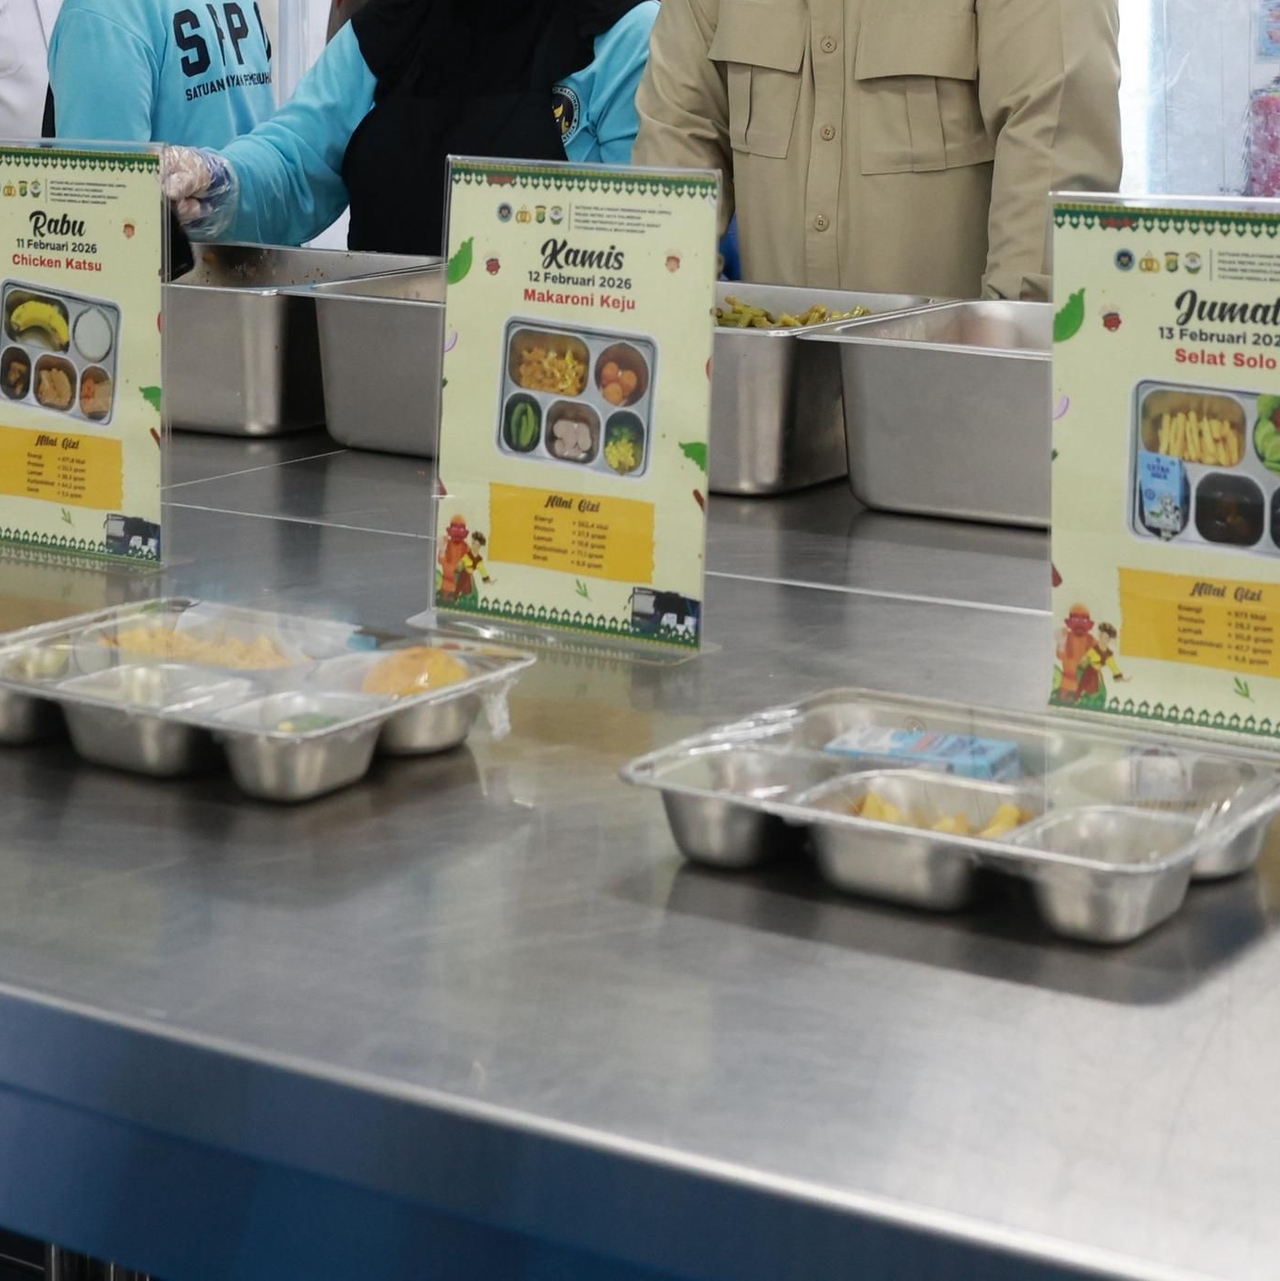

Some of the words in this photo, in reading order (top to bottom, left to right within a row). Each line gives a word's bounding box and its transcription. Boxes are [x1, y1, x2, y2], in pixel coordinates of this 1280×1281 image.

[185, 75, 226, 101] SATUAN
[29, 210, 86, 238] Rabu
[16, 239, 24, 248] 11
[27, 239, 68, 251] Februari
[72, 243, 97, 253] 2026
[540, 238, 625, 270] Kamis
[12, 254, 61, 269] Chicken
[66, 256, 102, 271] Katsu
[528, 271, 540, 283] 12
[544, 272, 595, 287] Februari
[599, 276, 632, 289] 2026
[524, 289, 594, 307] Makaroni
[600, 294, 636, 312] Keju
[1159, 326, 1173, 340] 13
[1180, 328, 1246, 345] Februari
[1175, 348, 1226, 366] Selat
[1233, 352, 1277, 370] Solo
[544, 495, 573, 509] Nilai
[577, 500, 600, 513] Gizi
[1188, 582, 1225, 598] Nilai
[1234, 588, 1263, 603] Gizi
